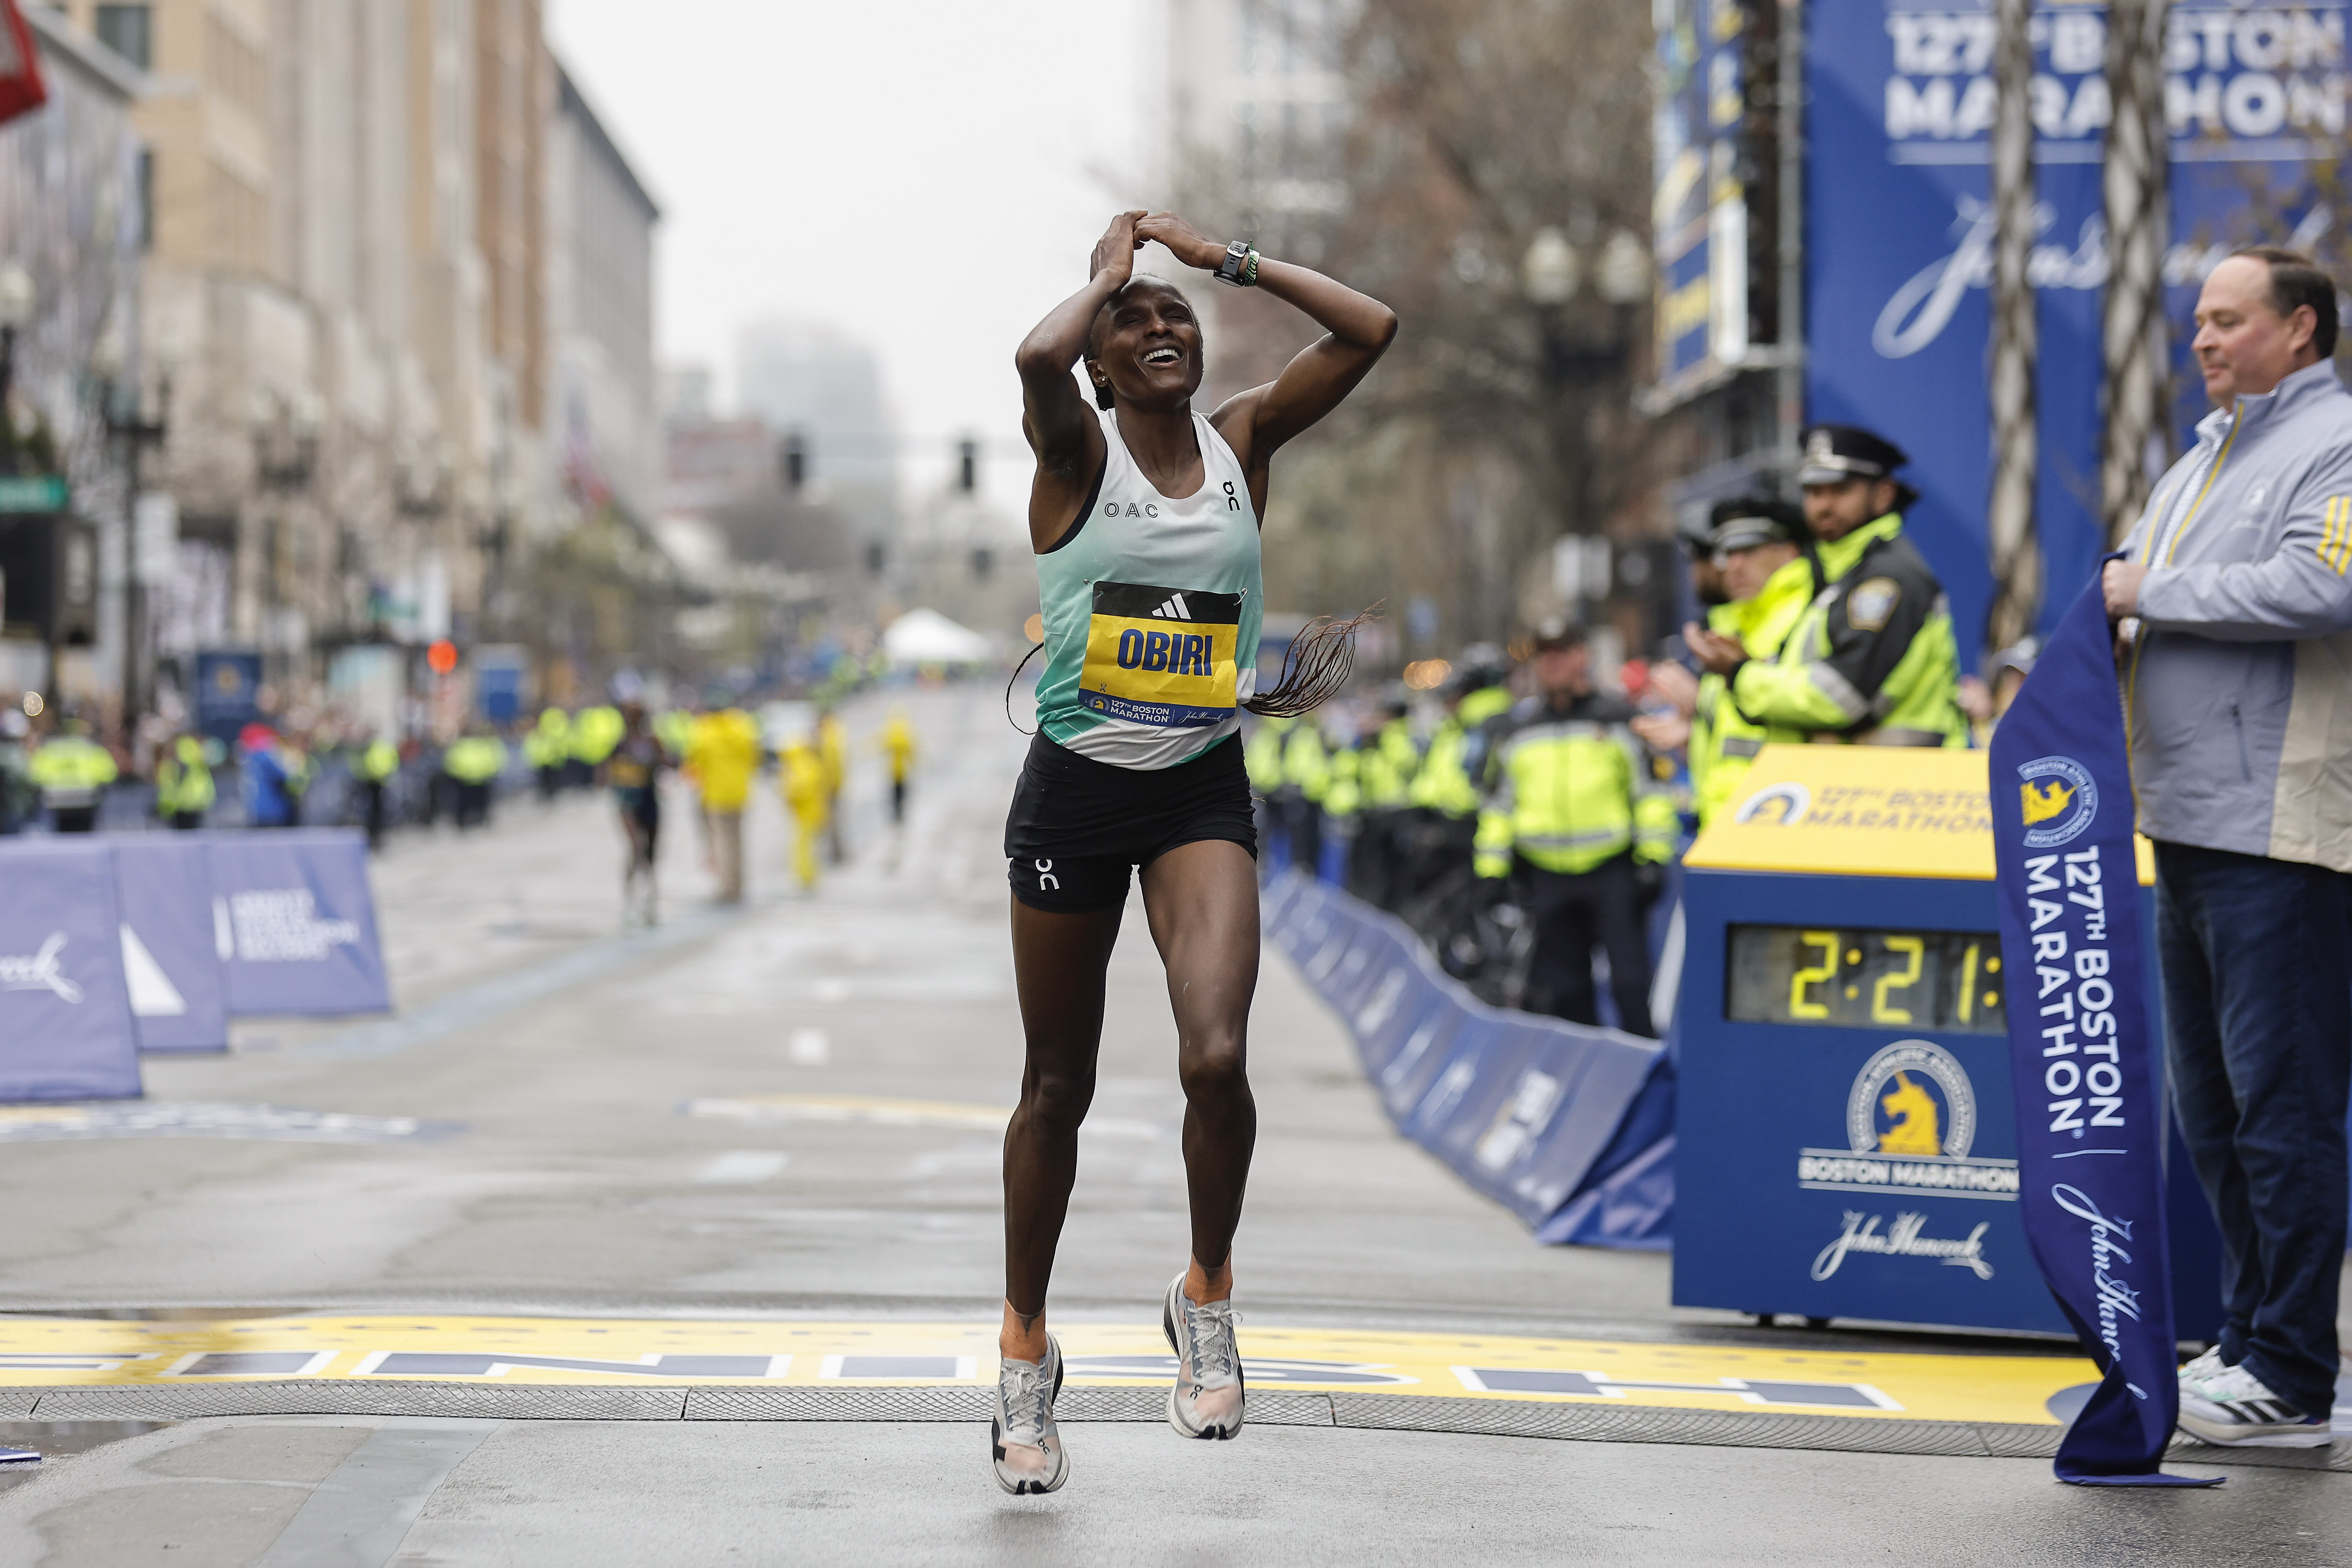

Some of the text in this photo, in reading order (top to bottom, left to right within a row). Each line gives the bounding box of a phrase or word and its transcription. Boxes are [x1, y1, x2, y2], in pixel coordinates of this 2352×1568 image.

[2049, 9, 2345, 73] BSTON
[1884, 72, 2347, 139] MARAHON
[1104, 502, 1158, 518] OAC
[1117, 629, 1213, 676] OBIRI
[1111, 699, 1131, 708] 127TH
[1132, 705, 1170, 715] BOSTON
[1178, 710, 1227, 723] John Hancock
[1886, 788, 1991, 810] BOSTO
[2064, 845, 2126, 1127] 127TH BOSTON
[1798, 1157, 2020, 1193] BOSTON MARATHON
[2051, 1183, 2133, 1270] John
